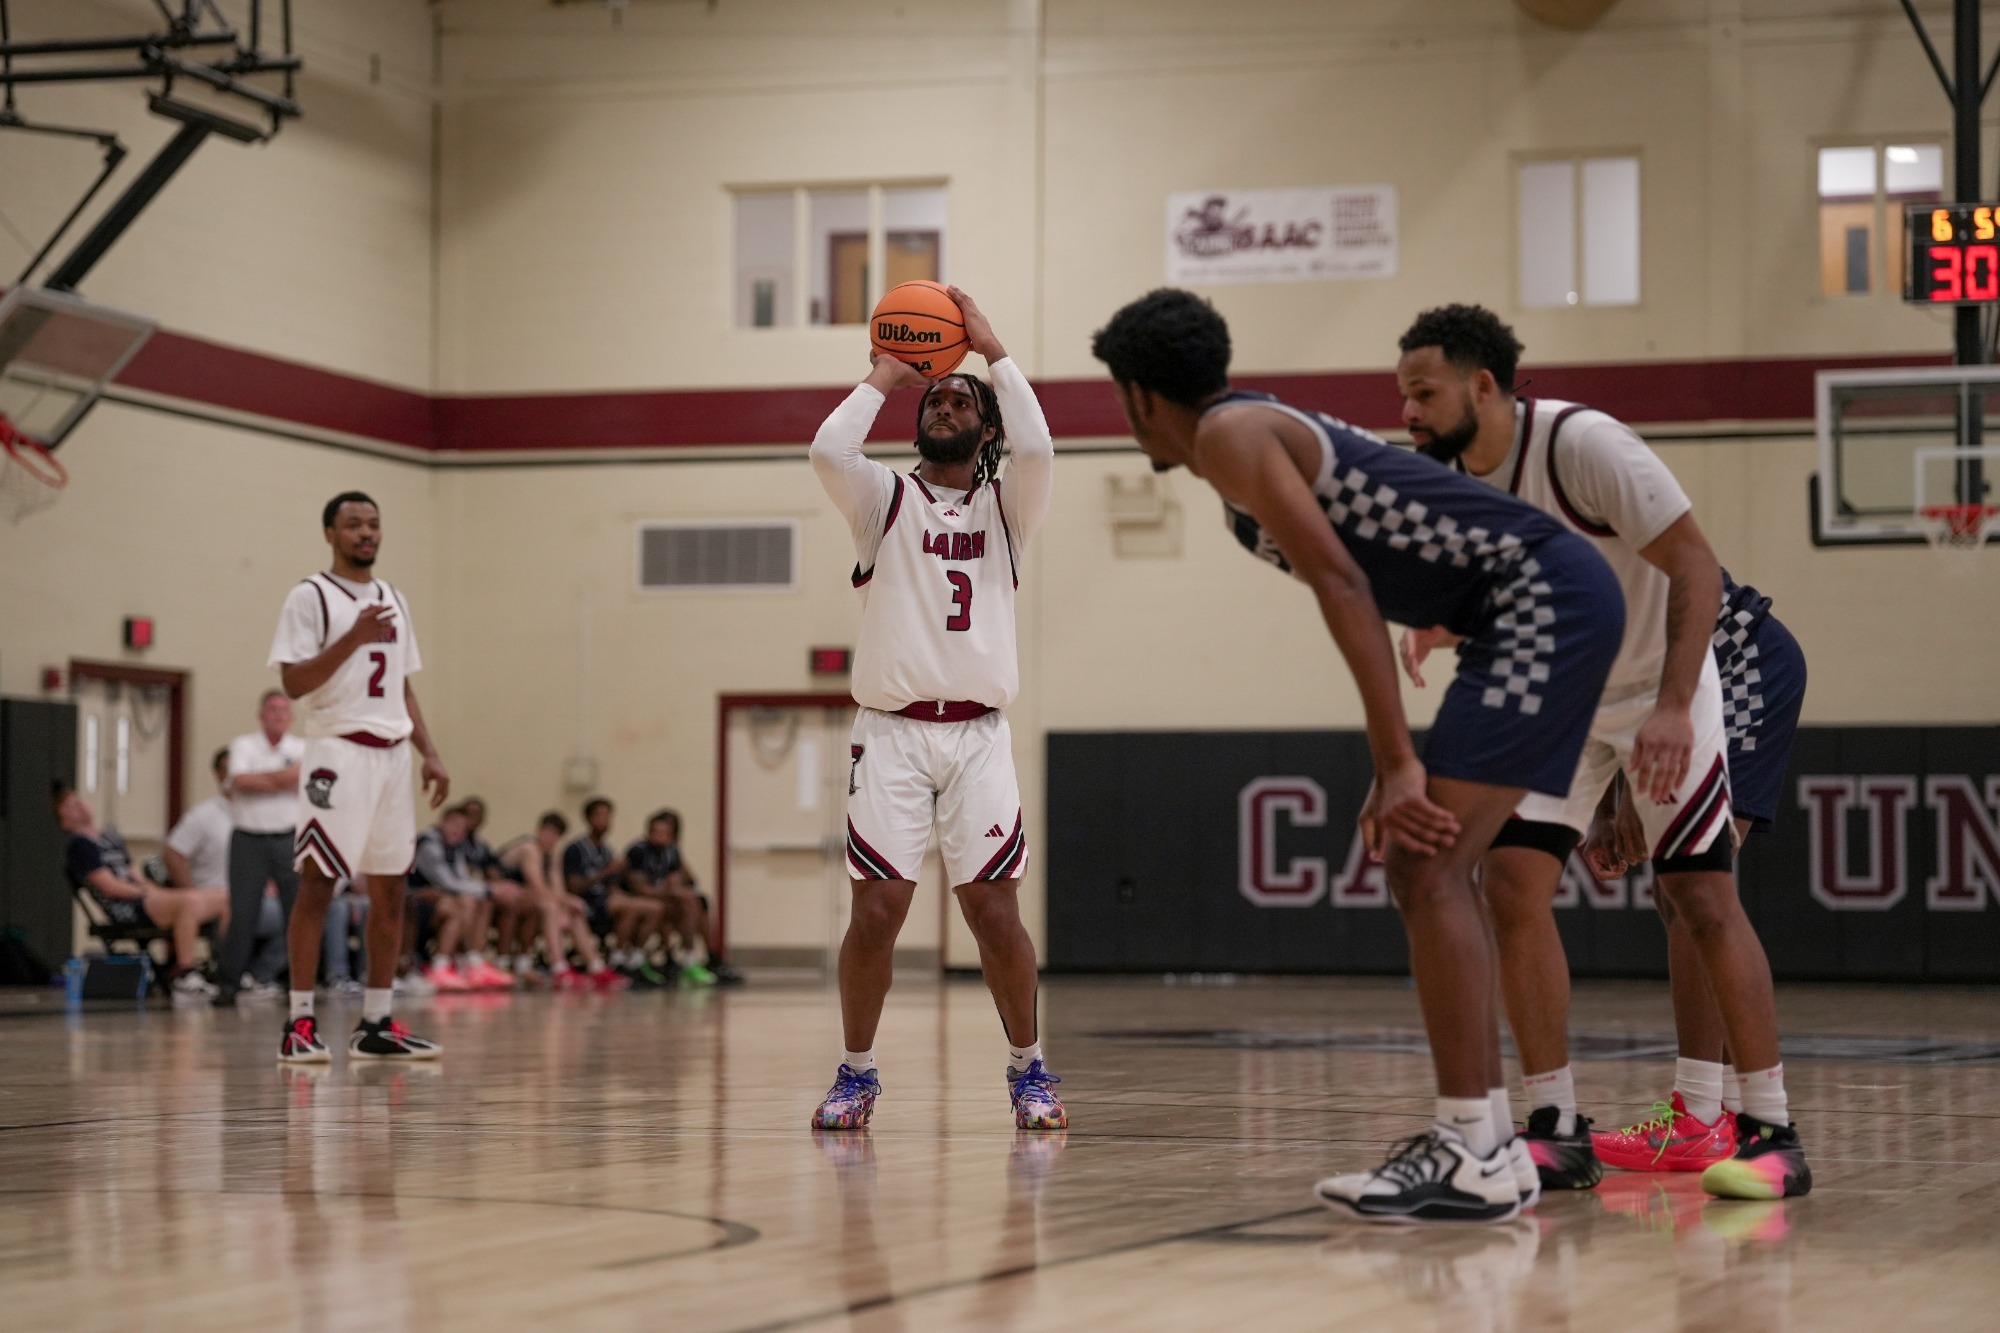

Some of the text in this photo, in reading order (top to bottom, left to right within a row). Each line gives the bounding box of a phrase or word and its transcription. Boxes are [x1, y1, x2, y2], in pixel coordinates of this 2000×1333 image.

[1931, 206, 2000, 242] 6:5
[1929, 245, 1998, 302] 30
[878, 323, 941, 343] Wilson
[946, 569, 973, 632] 3
[368, 651, 387, 698] 2
